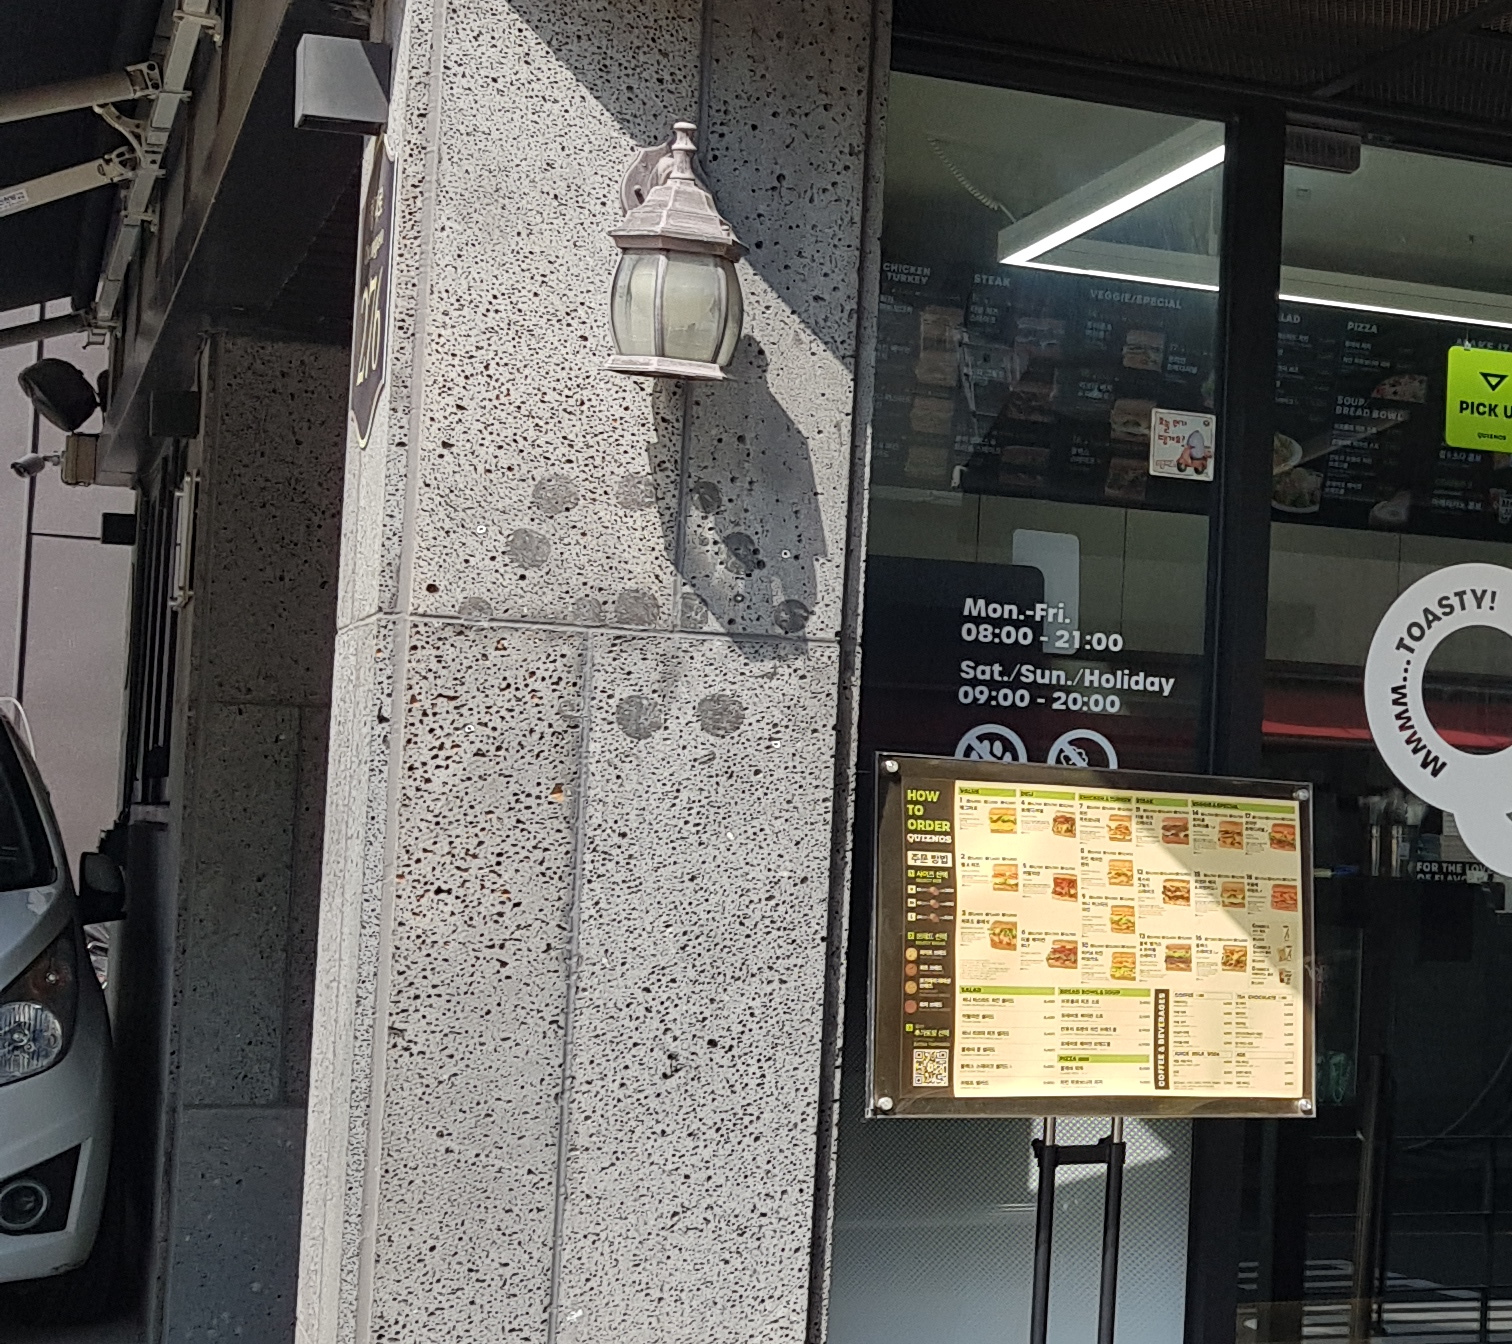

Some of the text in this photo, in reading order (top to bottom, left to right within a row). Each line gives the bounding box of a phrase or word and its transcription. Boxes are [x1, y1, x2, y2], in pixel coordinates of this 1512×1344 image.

[973, 273, 1011, 288] STEAK
[356, 266, 384, 387] 276
[1346, 321, 1379, 334] PIZZA
[1459, 400, 1498, 418] PICK
[962, 597, 1071, 624] Mon.-Fri.
[961, 622, 1034, 646] 08:00
[1054, 630, 1124, 653] 21:00
[959, 659, 1176, 697] Sat./Sun./Holiday
[957, 684, 1031, 708] 09:00
[1051, 691, 1121, 713] 20:00
[906, 789, 940, 802] HOW
[906, 804, 924, 816] TO
[906, 818, 951, 832] ORDER
[906, 833, 952, 844] QUIZNOS
[911, 853, 929, 864] 주문
[1416, 861, 1439, 873] FOR
[1441, 862, 1463, 873] THE
